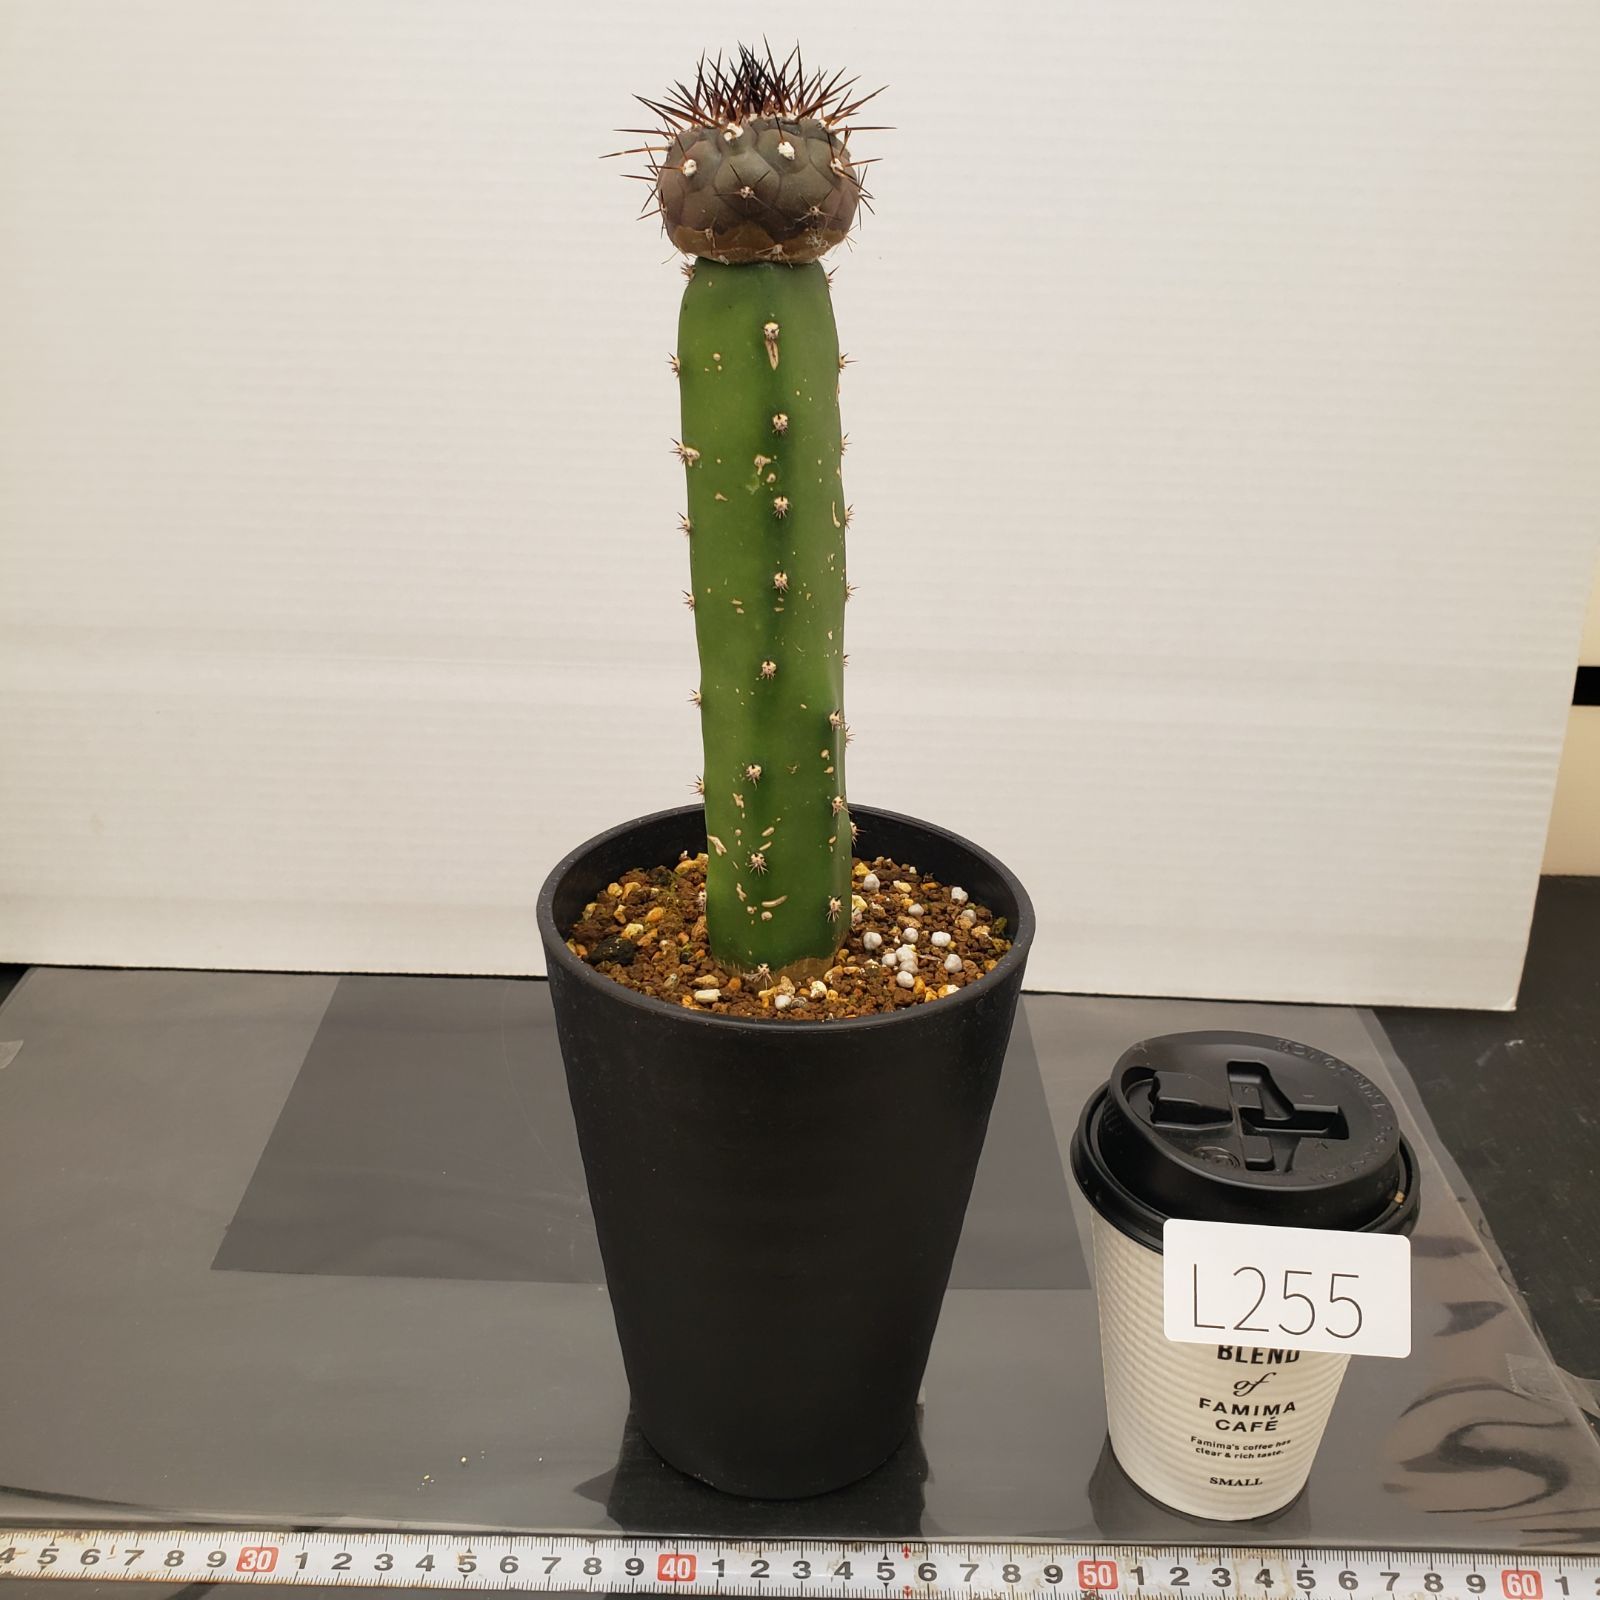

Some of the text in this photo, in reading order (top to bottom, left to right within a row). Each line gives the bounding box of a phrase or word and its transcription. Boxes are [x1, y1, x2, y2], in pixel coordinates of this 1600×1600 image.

[1193, 1263, 1363, 1339] L255
[1216, 1345, 1301, 1364] BLEND
[1233, 1372, 1277, 1397] of
[1198, 1397, 1297, 1417] FAMIMA
[1215, 1416, 1279, 1432] CAFÉ
[1190, 1435, 1240, 1451] Famima's
[1242, 1441, 1274, 1451] coffee
[1195, 1446, 1222, 1458] clear
[1209, 1476, 1263, 1487] SMALL
[37, 1548, 60, 1565] 5
[80, 1548, 101, 1566] 6
[124, 1549, 145, 1566] 7
[163, 1551, 184, 1568] 8
[206, 1552, 227, 1569] 9
[241, 1551, 273, 1571] 30
[295, 1553, 307, 1570] 1
[331, 1554, 352, 1571] 2
[374, 1555, 395, 1572] 3
[415, 1555, 436, 1572] 4
[456, 1556, 478, 1573] 5
[499, 1556, 520, 1574] 6
[541, 1557, 562, 1574] 7
[582, 1557, 603, 1576] 8
[625, 1558, 645, 1576] 9
[662, 1557, 691, 1579] 40
[711, 1559, 725, 1577] 1
[750, 1559, 770, 1579] 2
[792, 1560, 812, 1580] 3
[833, 1561, 854, 1580] 4
[876, 1562, 896, 1581] 5
[917, 1562, 938, 1582] 6
[959, 1563, 980, 1582] 7
[1001, 1564, 1021, 1583] 8
[1043, 1565, 1063, 1584] 9
[1082, 1563, 1112, 1586] 50
[1130, 1566, 1146, 1586] 1
[1169, 1567, 1190, 1586] 2
[1211, 1567, 1232, 1588] 3
[1254, 1568, 1274, 1589] 4
[1296, 1569, 1316, 1590] 5
[1338, 1570, 1359, 1591] 6
[1380, 1572, 1400, 1592] 7
[1423, 1573, 1444, 1592] 8
[1466, 1574, 1487, 1593] 9
[1506, 1573, 1537, 1597] 60
[1554, 1576, 1570, 1595] 1
